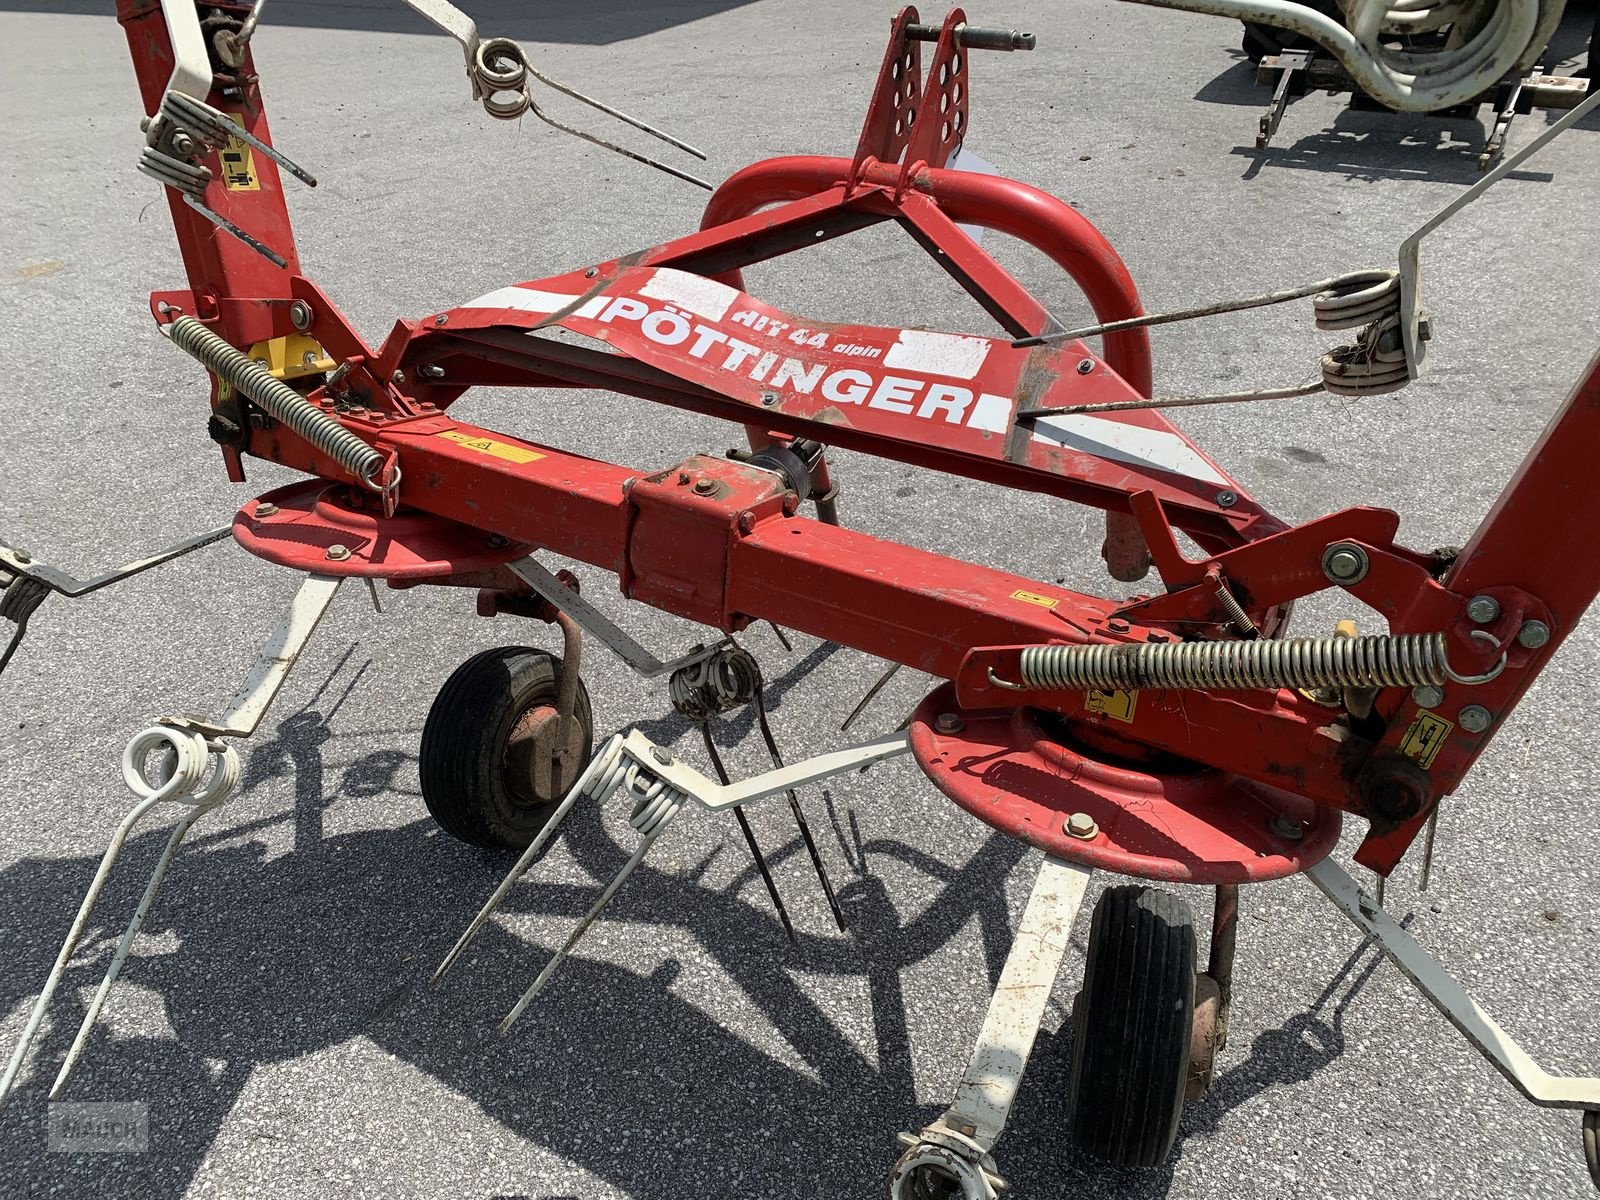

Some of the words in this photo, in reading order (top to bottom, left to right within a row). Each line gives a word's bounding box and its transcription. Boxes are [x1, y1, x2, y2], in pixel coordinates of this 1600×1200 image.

[598, 297, 974, 425] PÖTTINGER
[788, 328, 830, 348] 44
[833, 343, 882, 358] alpin
